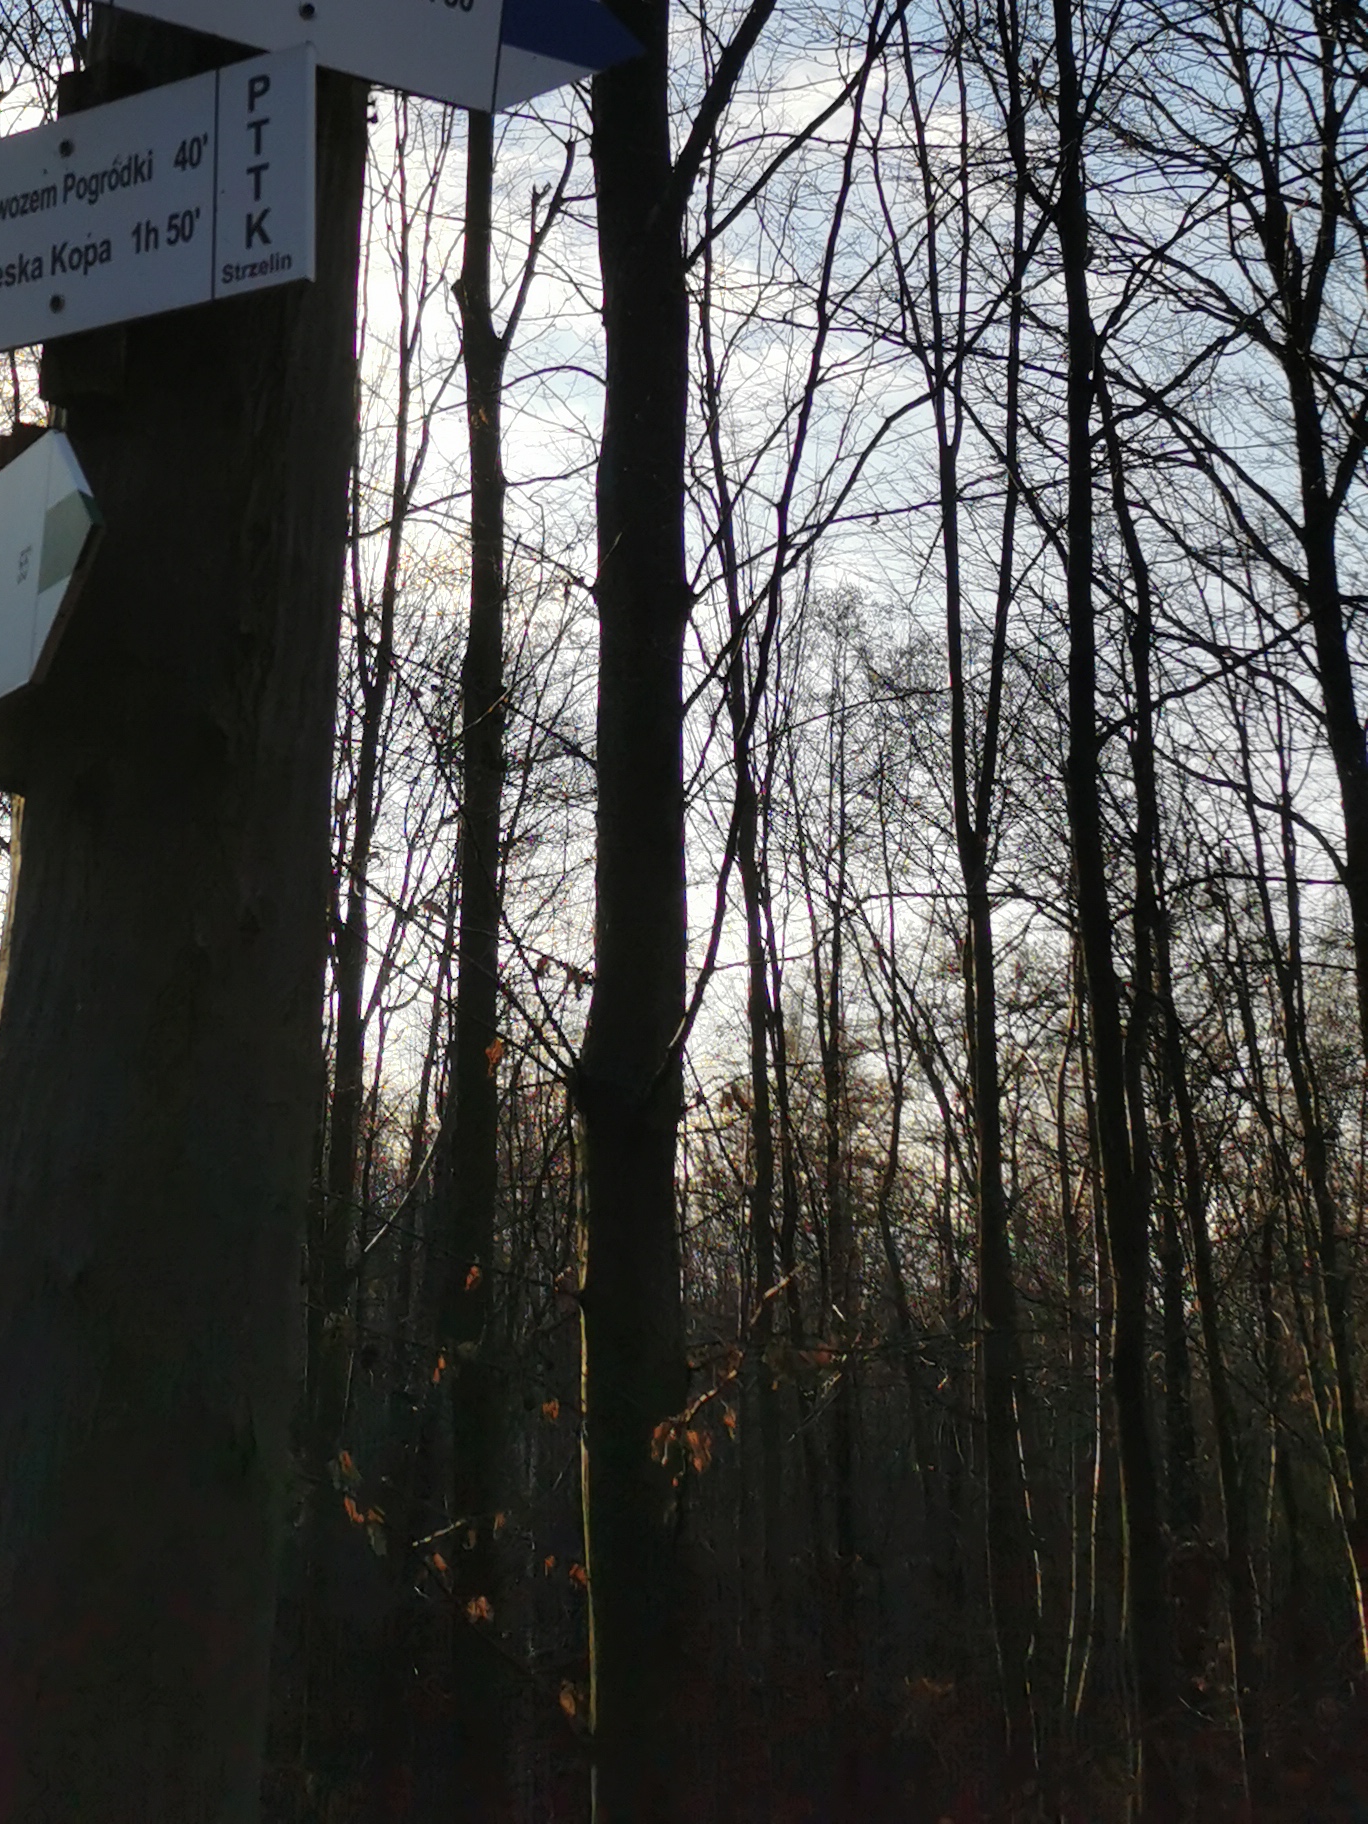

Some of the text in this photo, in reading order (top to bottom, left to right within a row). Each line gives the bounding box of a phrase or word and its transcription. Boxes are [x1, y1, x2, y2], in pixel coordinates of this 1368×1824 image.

[62, 149, 153, 205] Pogródki
[245, 74, 272, 250] PTTK
[51, 238, 112, 276] Kopa
[132, 219, 159, 255] 1h
[221, 252, 293, 284] Strzelin
